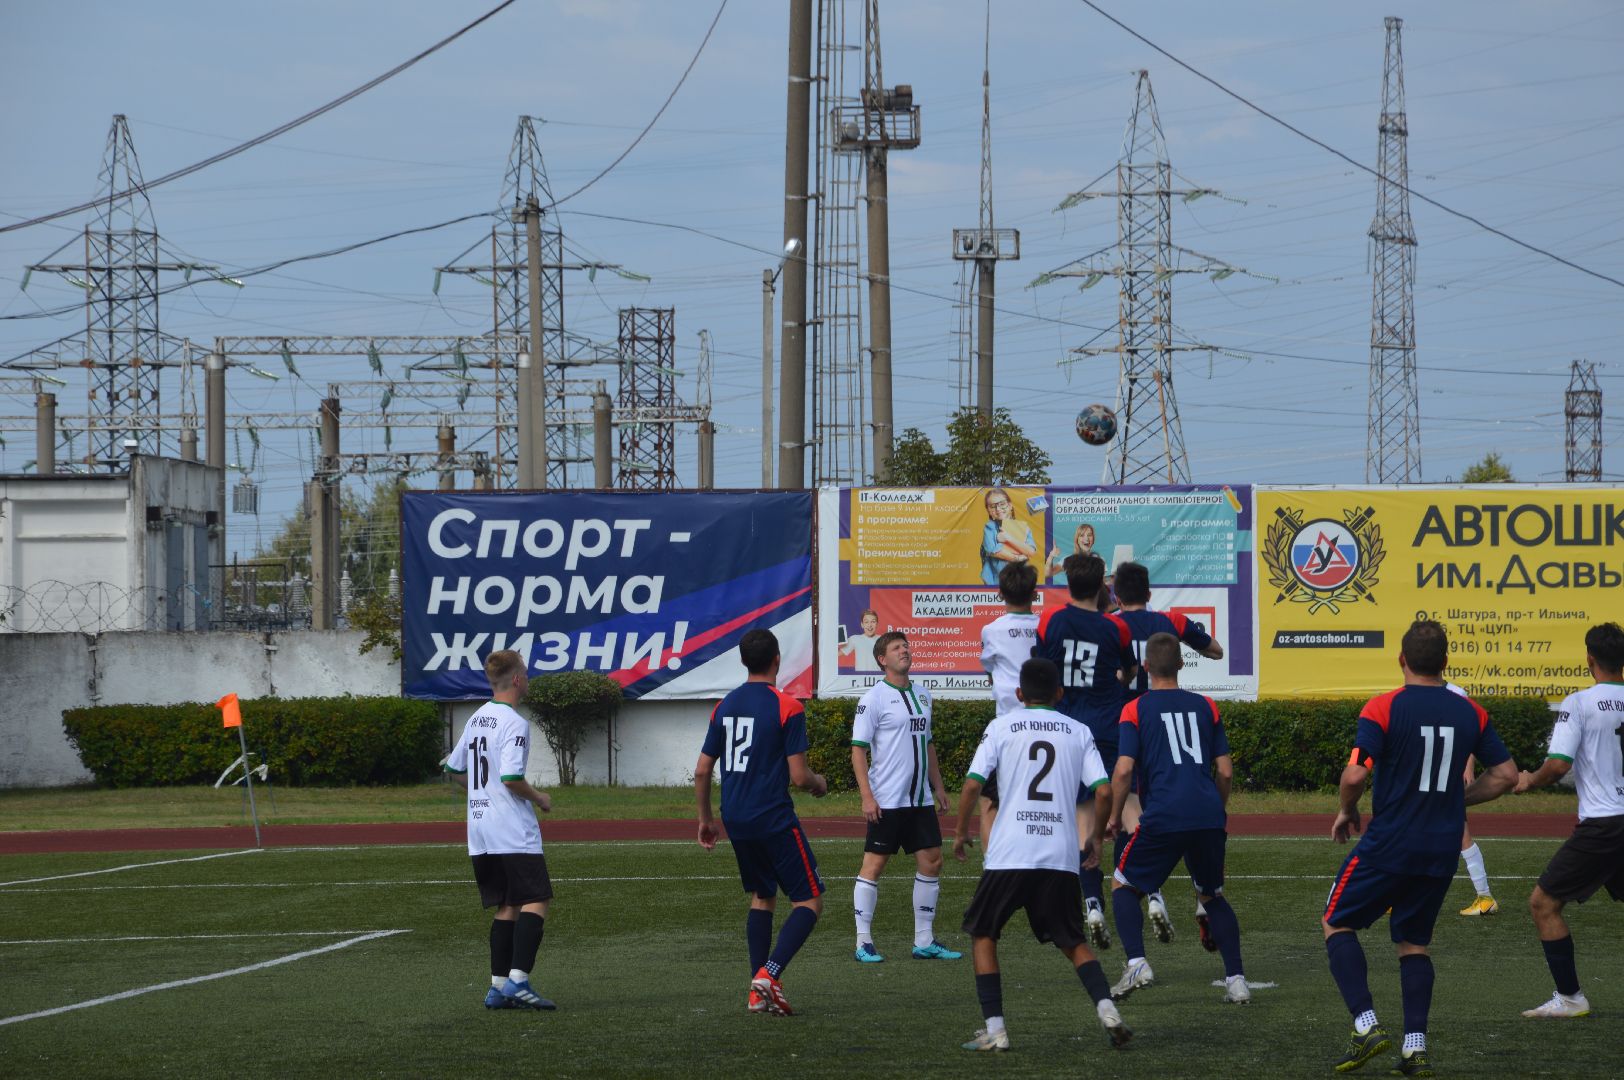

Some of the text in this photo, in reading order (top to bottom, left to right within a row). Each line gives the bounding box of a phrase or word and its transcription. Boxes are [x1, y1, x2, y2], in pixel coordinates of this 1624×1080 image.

[1056, 496, 1223, 505] ПРОФЕССИОНАЛЬНОЕ КОМПЬЮТЕРНОЕ
[1056, 506, 1118, 514] ОБРАЗОВАНИЕ
[867, 516, 929, 525] программе:
[1170, 518, 1234, 529] программе:
[428, 508, 651, 571] Спорт
[427, 575, 665, 627] норма
[915, 594, 953, 603] МАЛАЯ
[915, 607, 973, 617] АКАДЕМИЯ
[1448, 609, 1500, 621] Шатура,
[1506, 610, 1534, 621] пр-т
[1539, 609, 1590, 621] Ильича,
[1458, 624, 1475, 635] ТЦ
[1278, 633, 1365, 644] oz-avtoschool.ru
[423, 621, 689, 671] жизни!
[1485, 641, 1500, 653] 01
[1507, 641, 1523, 653] 14
[1528, 641, 1552, 653] 777
[1062, 639, 1099, 687] 13
[1443, 665, 1590, 678] ttps://vk.com/avtoda
[1010, 720, 1072, 735] ФК ЮНОСТЬ
[722, 716, 755, 772] 12
[1160, 712, 1204, 765] 14
[469, 736, 489, 790] 16
[1418, 725, 1455, 792] 11
[1027, 740, 1056, 802] 2
[1016, 811, 1064, 823] СЕРЕБРЯНЫЕ
[1026, 824, 1053, 836] ПРУДЫ
